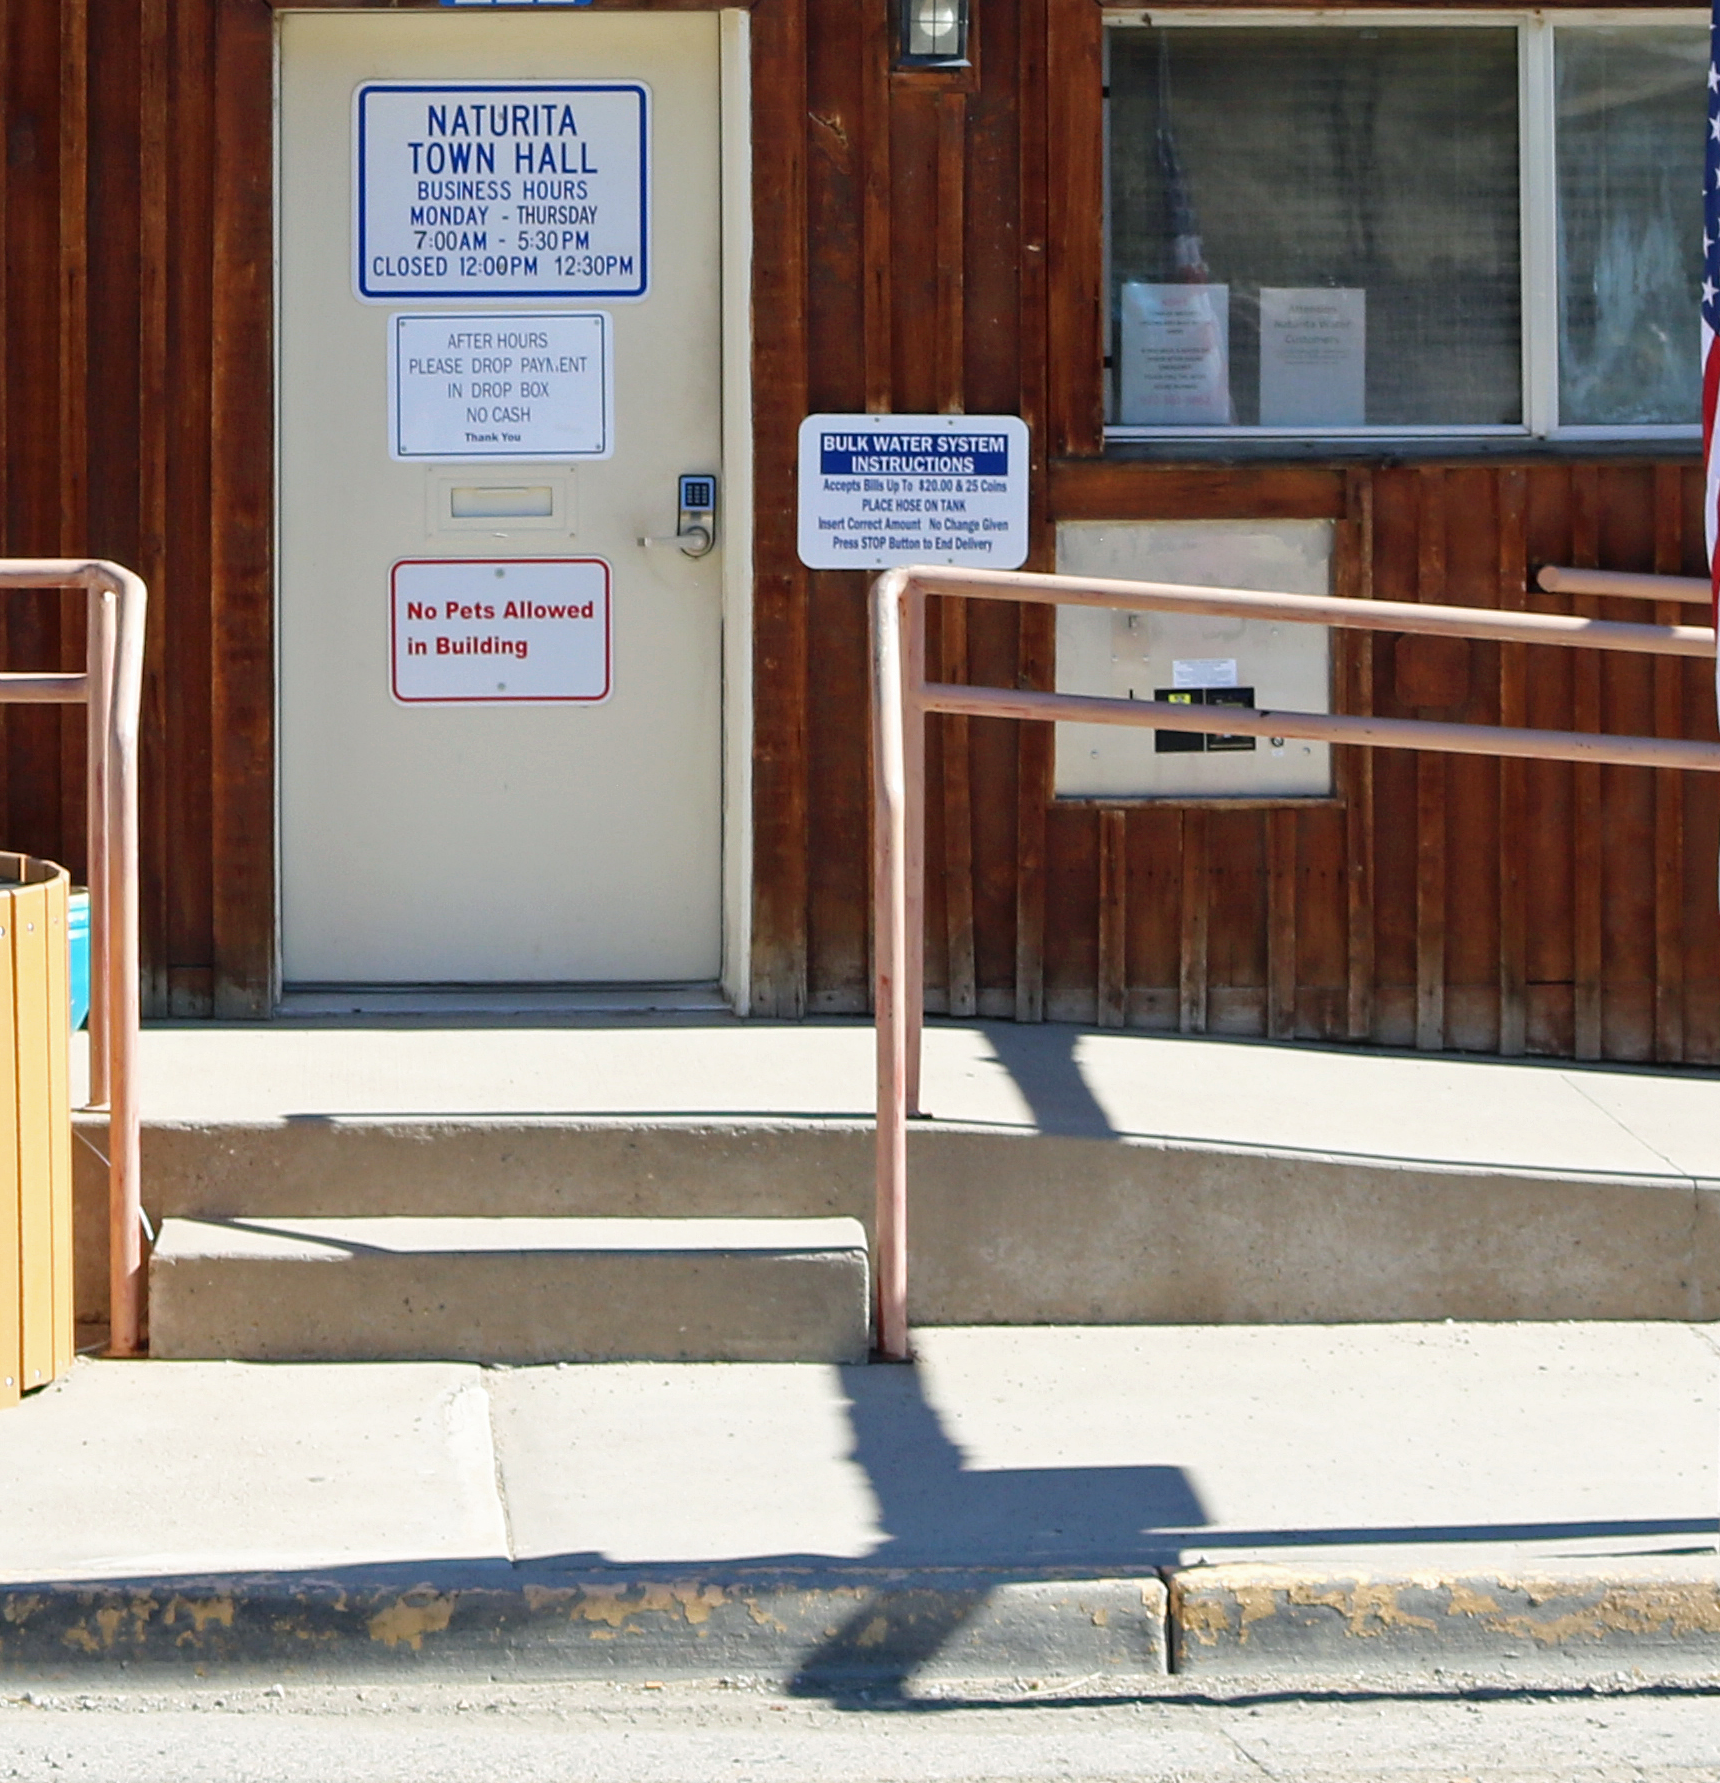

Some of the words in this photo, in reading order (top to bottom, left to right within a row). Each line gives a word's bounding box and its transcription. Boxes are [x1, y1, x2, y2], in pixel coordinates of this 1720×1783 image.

[428, 104, 577, 136] NATURITA
[408, 142, 495, 174] TOWN
[515, 142, 598, 174] HALL
[418, 180, 512, 201] BUSINESS
[523, 180, 588, 201] HOURS
[410, 206, 489, 226] MONDAY
[517, 206, 598, 225] THURSDAY
[414, 230, 487, 251] 7:00AM
[372, 256, 448, 276] CLOSED
[460, 256, 538, 276] 12:00PM
[554, 255, 633, 276] 12:30PM
[448, 333, 493, 349] AFTER
[497, 332, 548, 349] HOURS
[409, 358, 463, 374] PLEASE
[472, 357, 513, 374] DROP
[448, 382, 463, 398] IN
[472, 382, 512, 398] DROP
[521, 381, 550, 398] BOX
[466, 407, 488, 423] NO
[492, 406, 531, 422] CASH
[465, 432, 498, 443] Thank
[501, 432, 521, 442] You
[823, 435, 869, 452] BULK
[873, 436, 933, 452] WATER
[936, 436, 1005, 453] SYSTEM
[851, 456, 974, 473] INSTRUCTIONS
[823, 478, 861, 494] Accepts
[864, 478, 884, 491] Bills
[887, 479, 900, 494] Up
[902, 479, 913, 491] To
[919, 479, 953, 492] $20.00
[955, 479, 964, 492] &
[966, 479, 978, 492] 25
[981, 479, 1007, 493] Coins
[862, 499, 894, 512] PLACE
[896, 499, 922, 512] HOSE
[924, 499, 938, 512] ON
[940, 499, 966, 512] TANK
[818, 517, 845, 530] Insert
[848, 517, 882, 530] Correct
[885, 517, 921, 531] Amount
[929, 518, 942, 531] No
[944, 518, 980, 533] Change
[982, 518, 1008, 531] Given
[833, 536, 859, 549] Press
[861, 537, 886, 549] STOP
[889, 537, 920, 550] Button
[923, 538, 933, 550] to
[935, 537, 953, 550] End
[956, 537, 993, 553] Delivery
[407, 601, 437, 620] No
[445, 601, 495, 620] Pets
[503, 600, 594, 619] Allowed
[407, 637, 427, 655] in
[436, 636, 528, 659] Building
